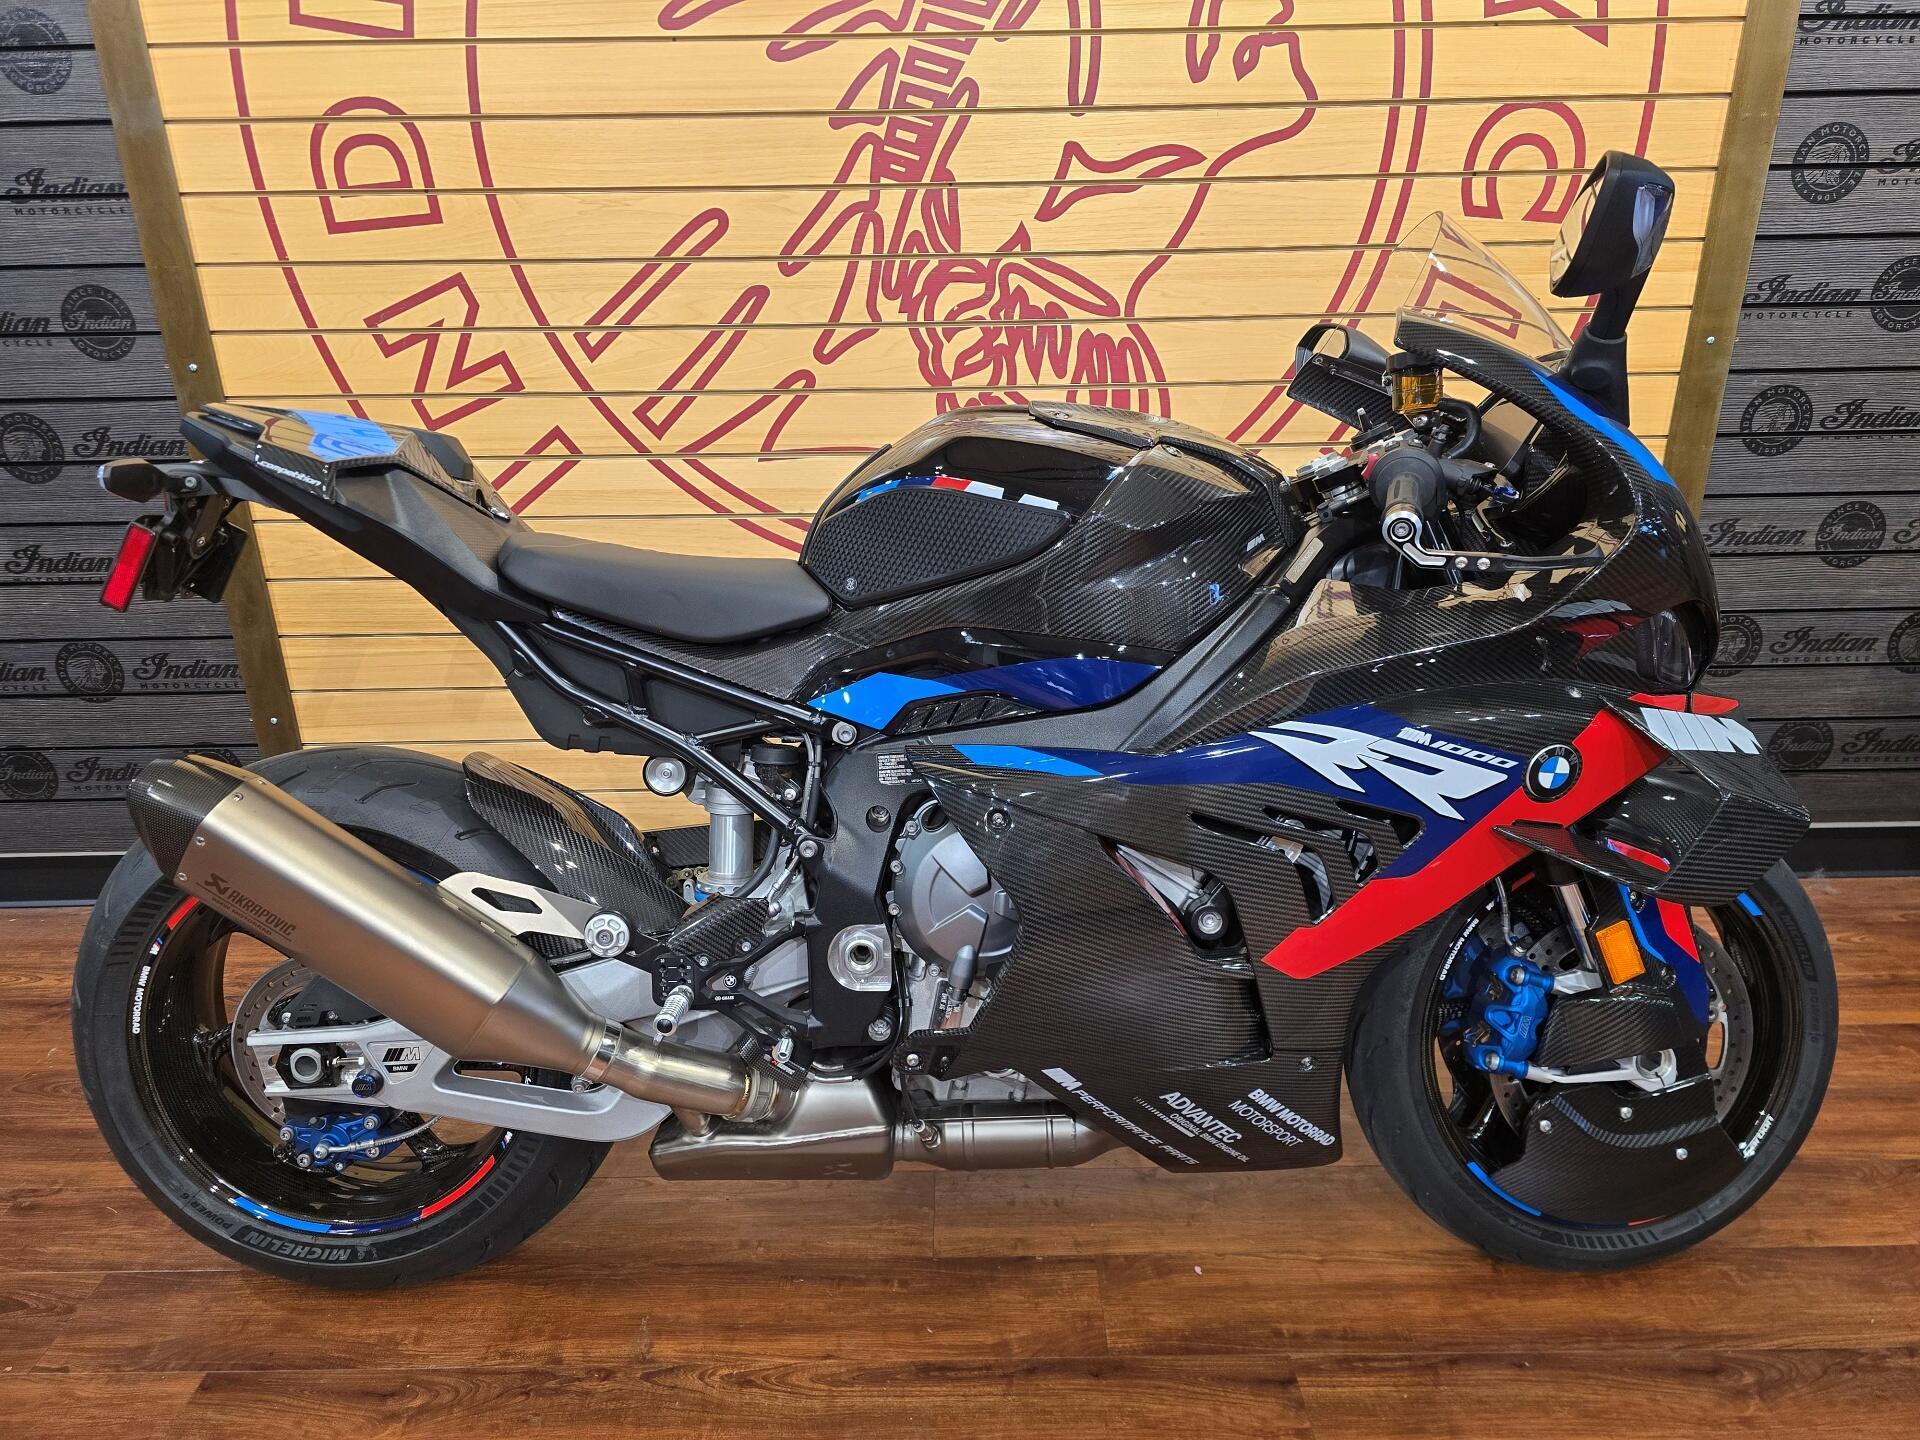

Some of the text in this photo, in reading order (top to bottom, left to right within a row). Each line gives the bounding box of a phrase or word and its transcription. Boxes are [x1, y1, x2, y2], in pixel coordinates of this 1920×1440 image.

[1799, 35, 1914, 44] MOTORCYCLE
[4, 167, 126, 204] Indian
[14, 206, 127, 216] MOTORCYCLE
[1744, 274, 1862, 303] Indian
[62, 311, 132, 332] Indian
[1744, 311, 1854, 320] MOTORCYCLE
[73, 426, 187, 457] Indian
[1703, 518, 1807, 547] Indian
[1769, 626, 1878, 655] Indian
[132, 652, 241, 681] Indian
[1439, 936, 1465, 981] MOTORRAD
[131, 965, 152, 1035] BMW MOTORRAD
[1071, 1088, 1163, 1145] PERFORMANCE
[1159, 1144, 1200, 1165] PARTS
[1159, 1091, 1242, 1143] ADVANTEC
[1170, 1112, 1203, 1136] ORIGINAL
[1227, 1099, 1304, 1147] MOTORSPORT
[1247, 1088, 1336, 1147] BMW MOTORRAD
[242, 1230, 352, 1261] MICHELIN
